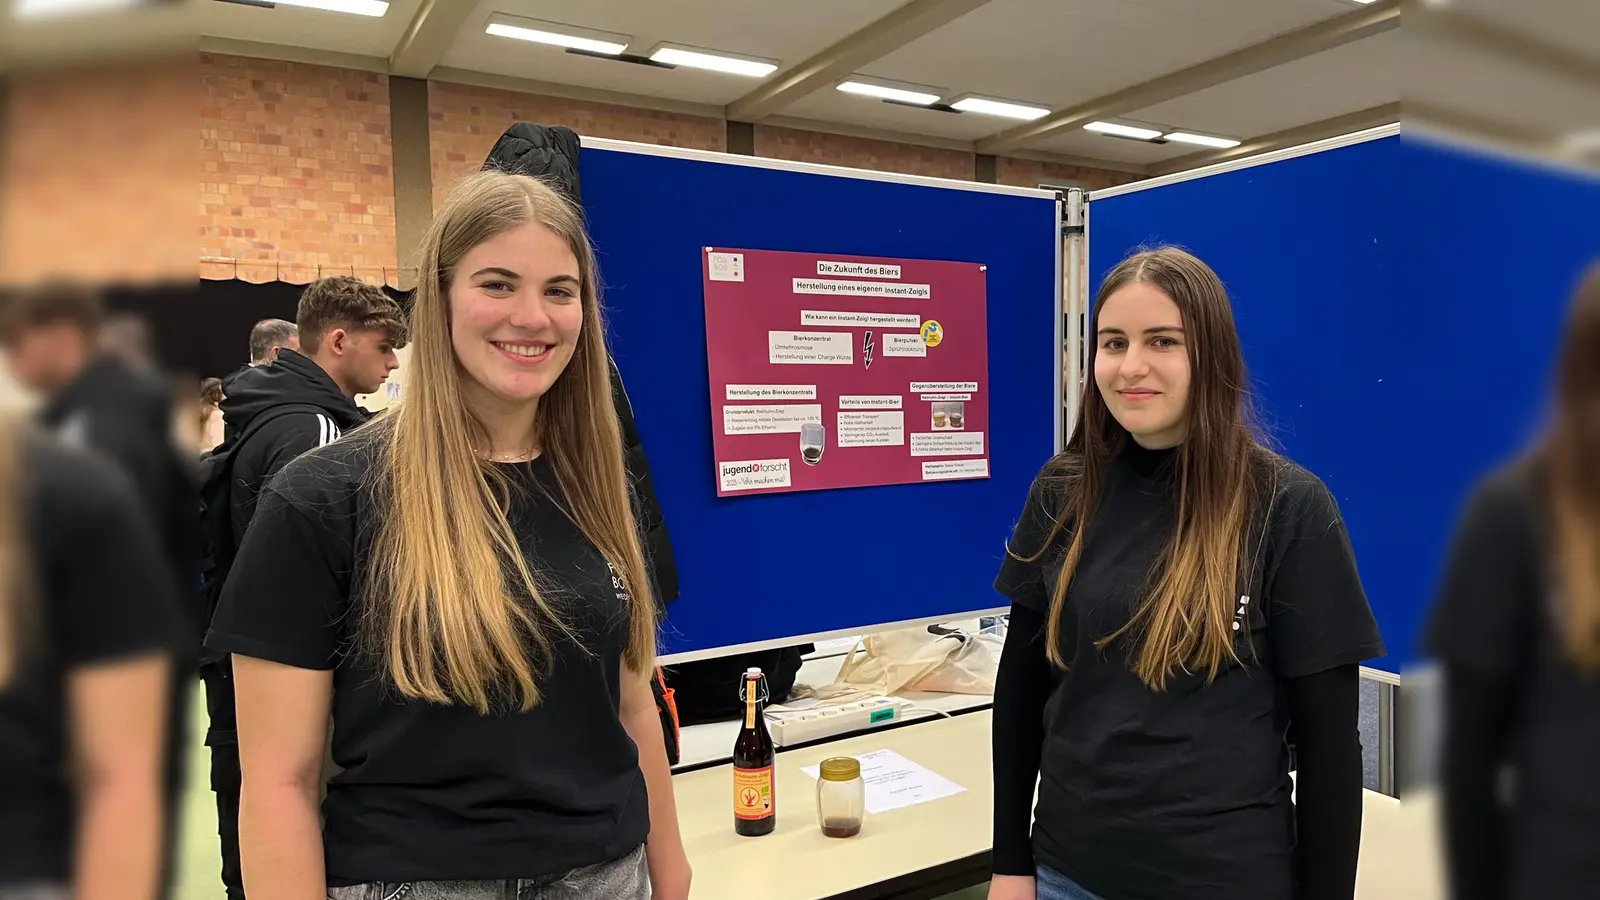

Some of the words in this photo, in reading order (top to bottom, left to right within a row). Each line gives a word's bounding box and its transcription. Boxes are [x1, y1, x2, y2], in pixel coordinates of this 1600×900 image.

[818, 263, 832, 272] Die
[833, 264, 863, 274] Zukunft
[864, 266, 878, 275] des
[879, 267, 899, 276] Biers
[796, 281, 836, 292] Herstellung
[837, 284, 856, 292] eines
[856, 285, 883, 294] eigenen
[884, 286, 928, 297] Instant-Zoigls
[870, 316, 896, 324] hergestellt
[888, 346, 924, 354] Sprühtrocknung
[817, 354, 836, 362] Charge
[912, 382, 955, 390] Gegenüberstellung
[722, 464, 752, 476] jugend
[760, 462, 788, 472] forscht
[612, 576, 625, 590] BO
